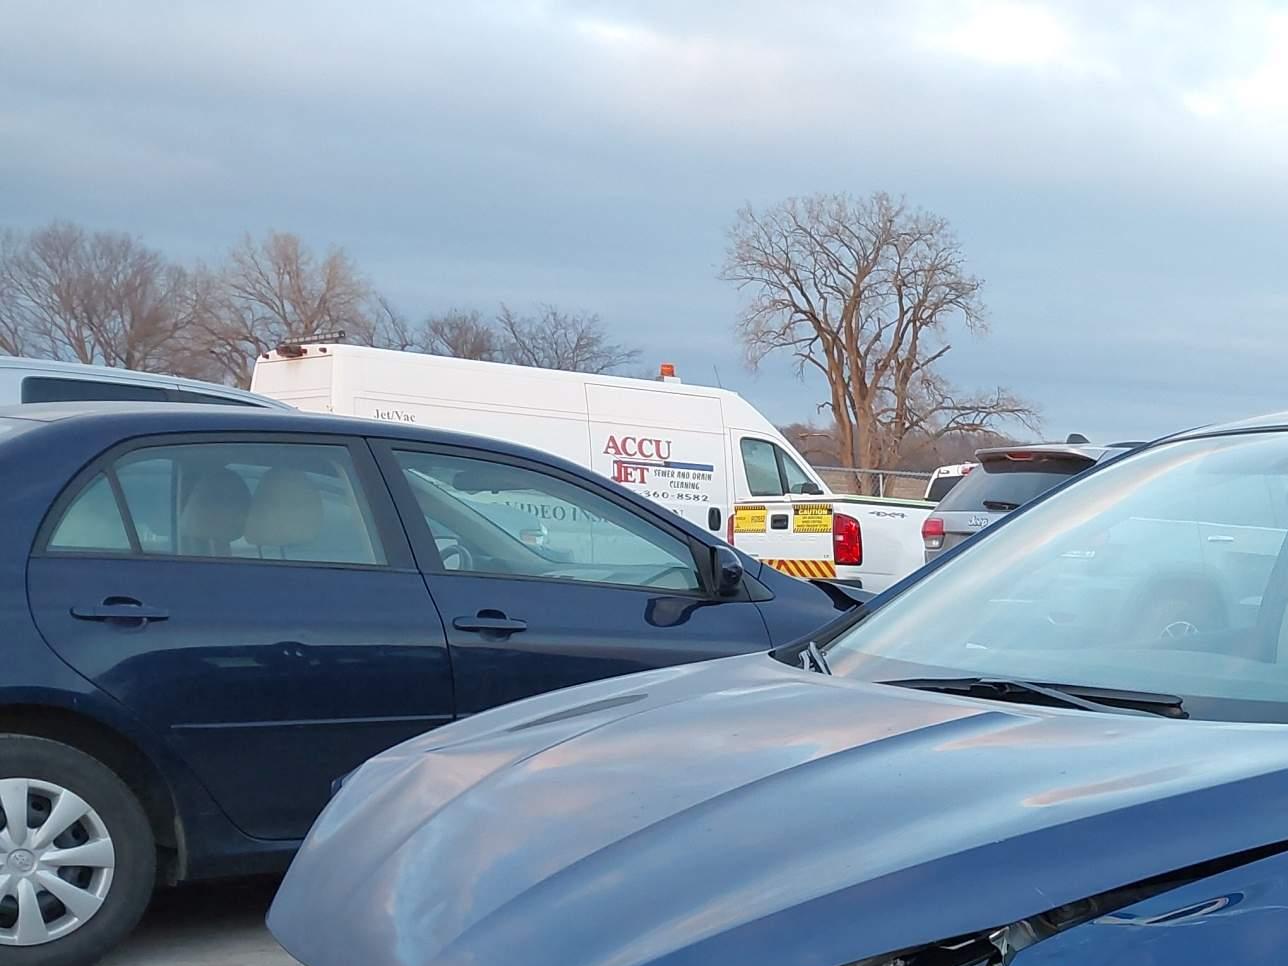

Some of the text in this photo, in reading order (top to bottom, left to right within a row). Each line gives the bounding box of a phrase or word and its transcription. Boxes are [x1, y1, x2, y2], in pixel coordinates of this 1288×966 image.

[374, 409, 416, 422] Jet/Vac
[603, 435, 672, 460] ACCU
[611, 460, 649, 484] JET
[653, 469, 712, 481] SEWER AND DRAIN
[669, 480, 700, 490] CLEANING
